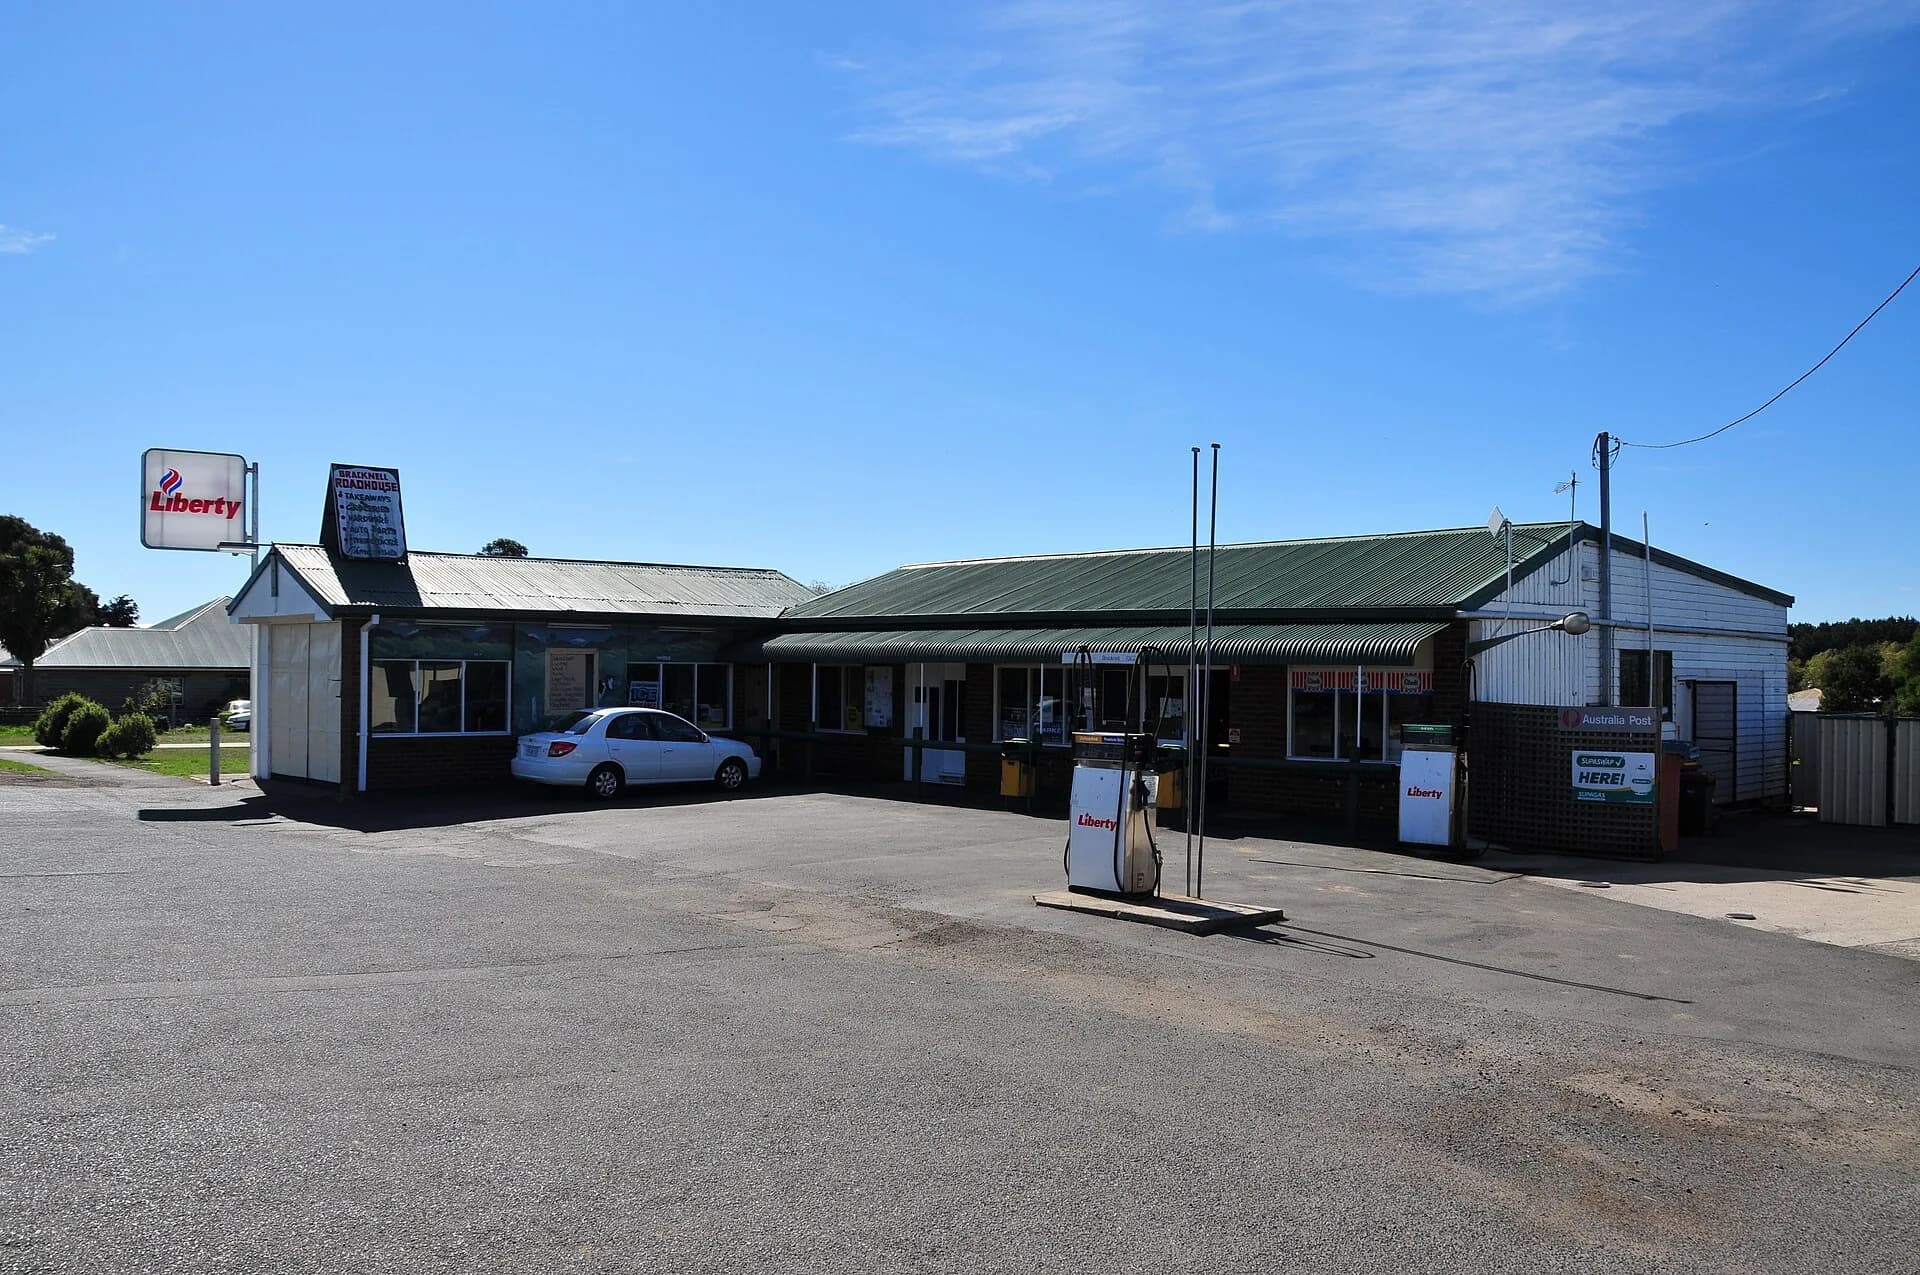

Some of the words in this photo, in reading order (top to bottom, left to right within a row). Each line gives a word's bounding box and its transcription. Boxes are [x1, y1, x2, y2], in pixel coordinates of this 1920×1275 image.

[339, 470, 388, 481] BRACKNELL
[335, 478, 399, 492] ROADHOUSE
[344, 492, 392, 503] TAKEAWAYS
[150, 491, 241, 519] Liberty
[631, 687, 657, 702] ICE
[1582, 713, 1625, 725] Australia
[1629, 715, 1652, 726] Post
[1578, 771, 1625, 786] HERE!
[1407, 786, 1443, 800] Liberty
[1078, 813, 1118, 832] Liberty
